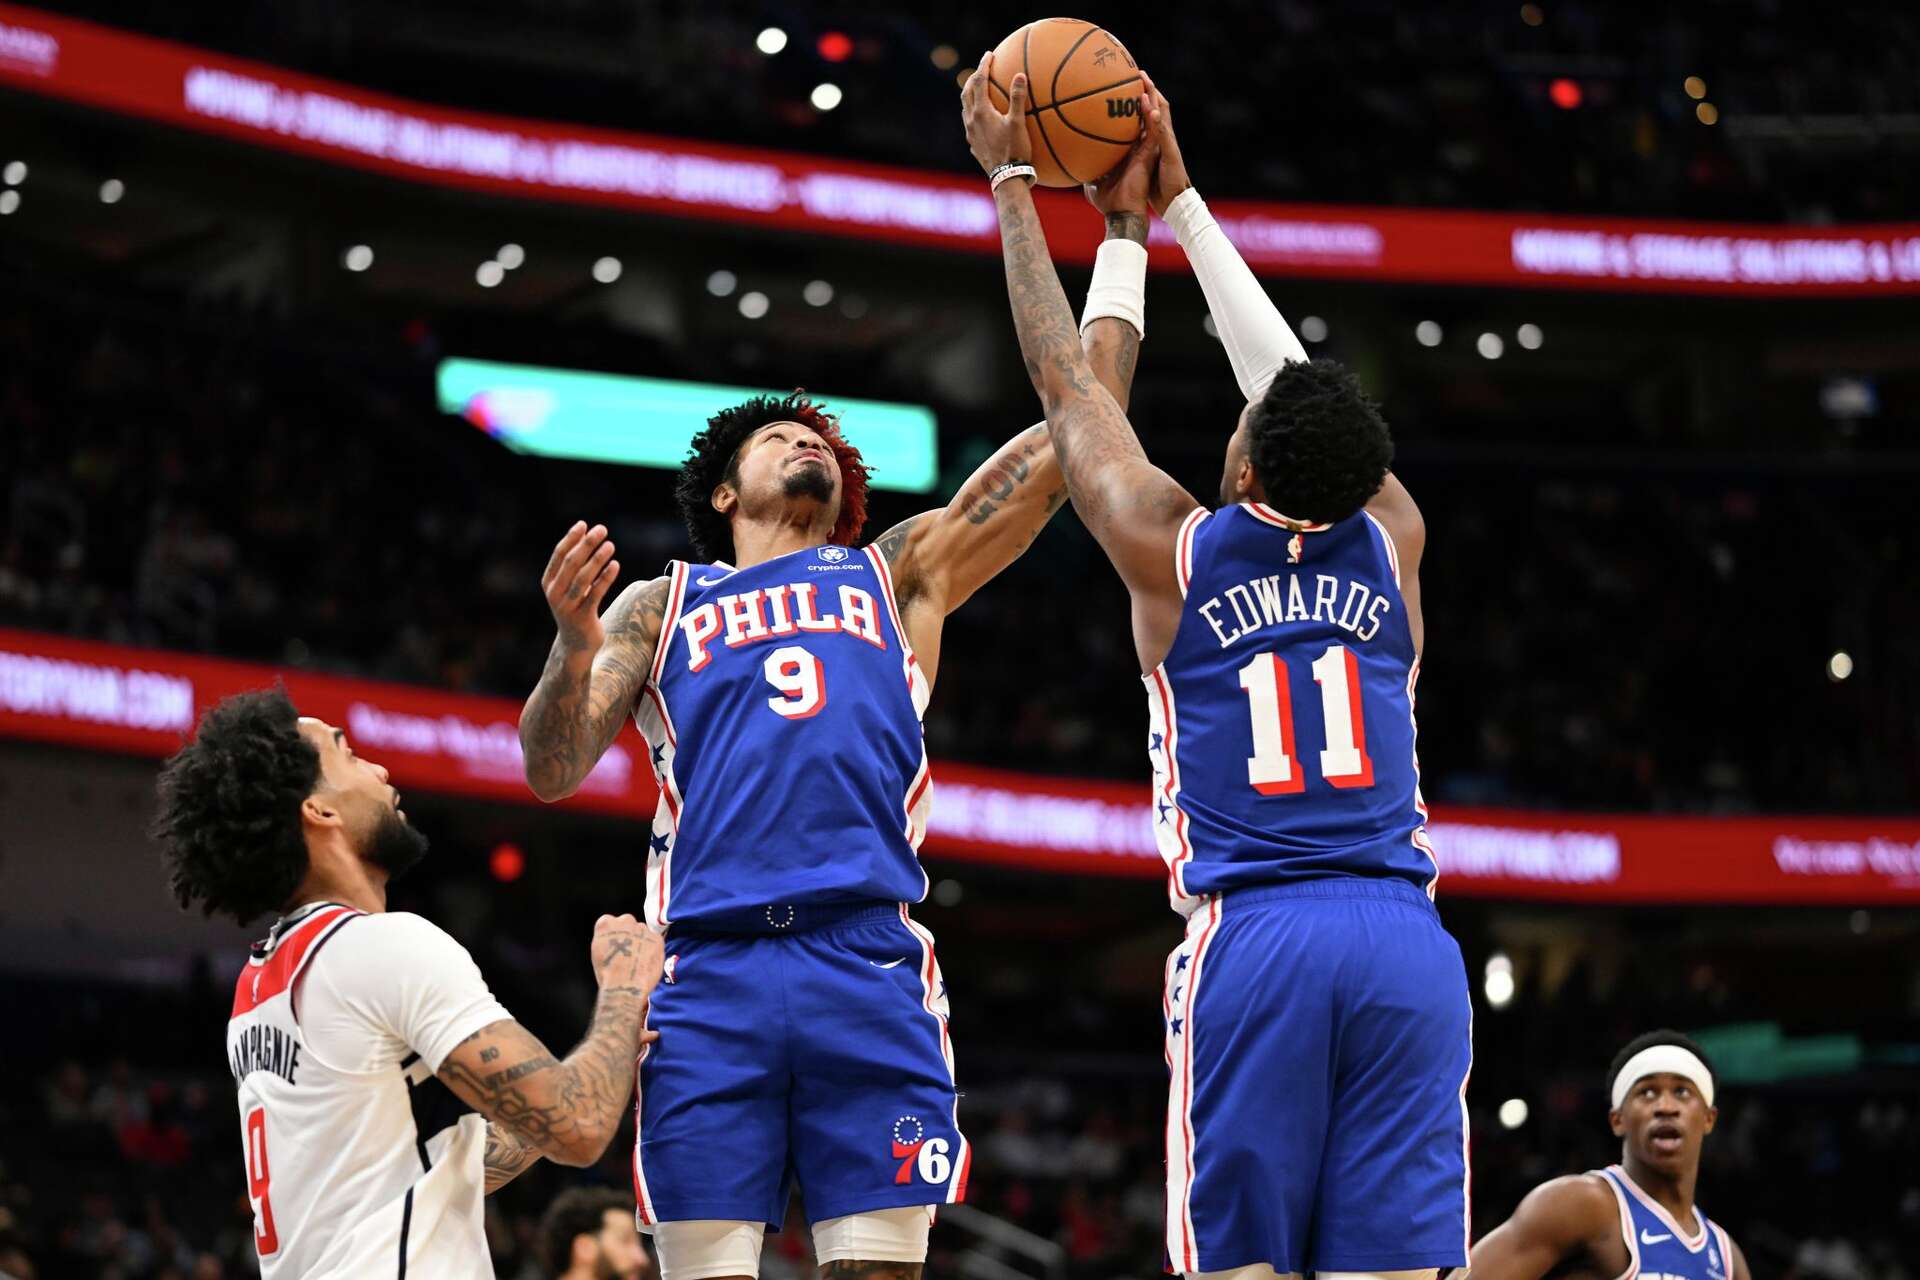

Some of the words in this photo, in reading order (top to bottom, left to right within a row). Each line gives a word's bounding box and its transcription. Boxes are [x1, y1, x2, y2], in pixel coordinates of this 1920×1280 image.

[807, 564, 864, 572] crypto.com
[679, 582, 887, 673] PHILA
[1198, 574, 1390, 649] EDWARDS
[764, 646, 827, 720] 9
[1238, 645, 1376, 796] 11
[247, 1106, 280, 1257] 9
[892, 1136, 951, 1185] 76
